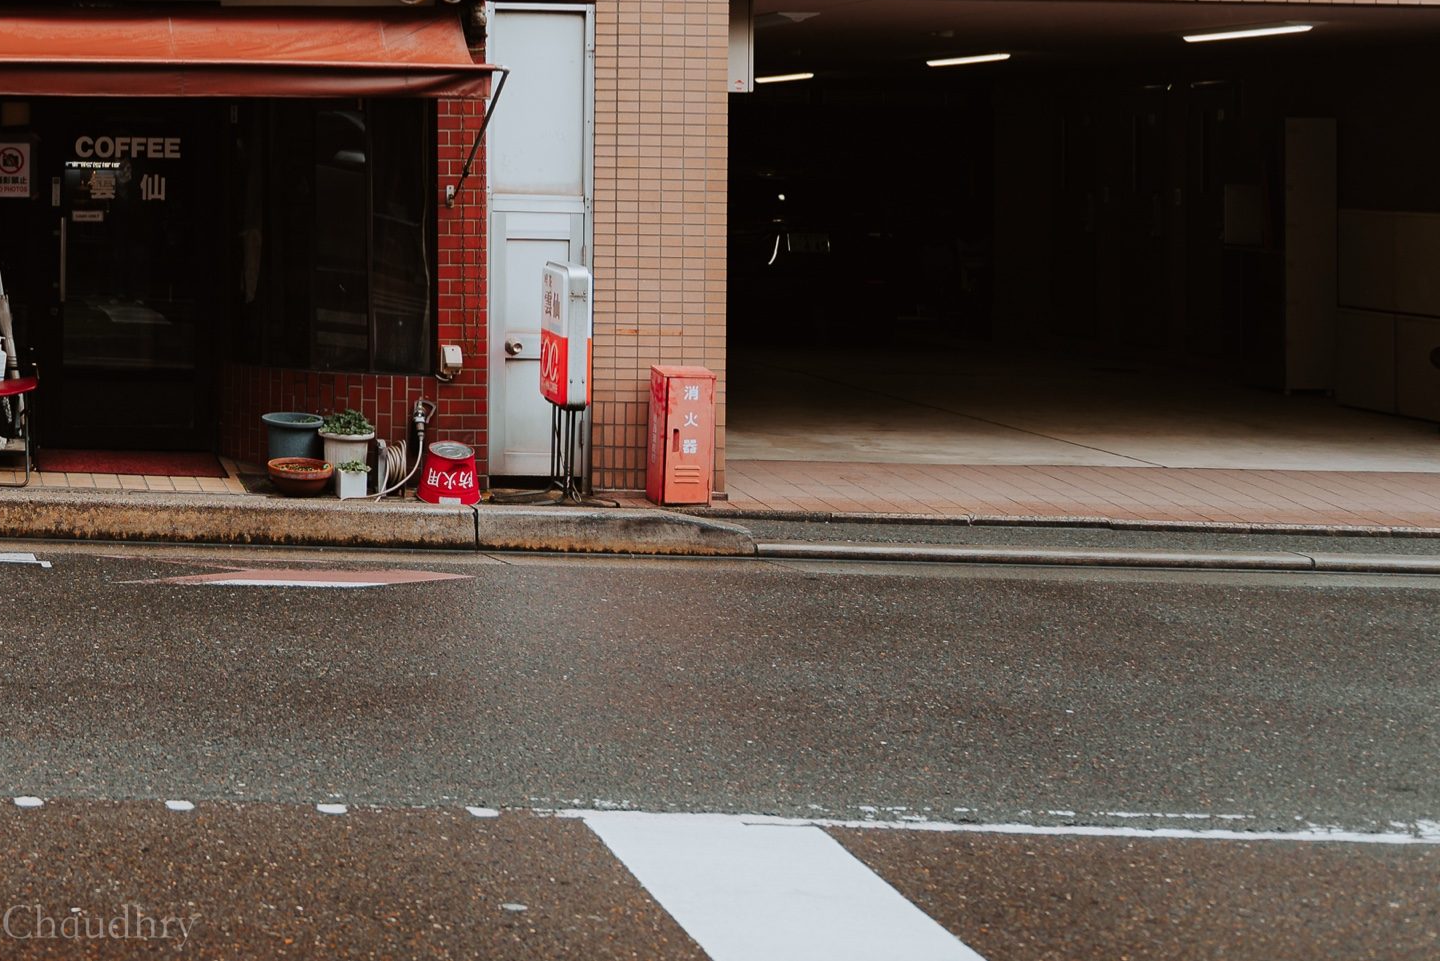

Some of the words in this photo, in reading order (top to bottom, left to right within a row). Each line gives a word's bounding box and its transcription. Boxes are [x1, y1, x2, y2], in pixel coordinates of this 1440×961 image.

[75, 136, 181, 159] COFFEE
[4, 185, 28, 193] PHOTOS
[682, 385, 699, 454] 消火器
[427, 467, 474, 490] 防火用
